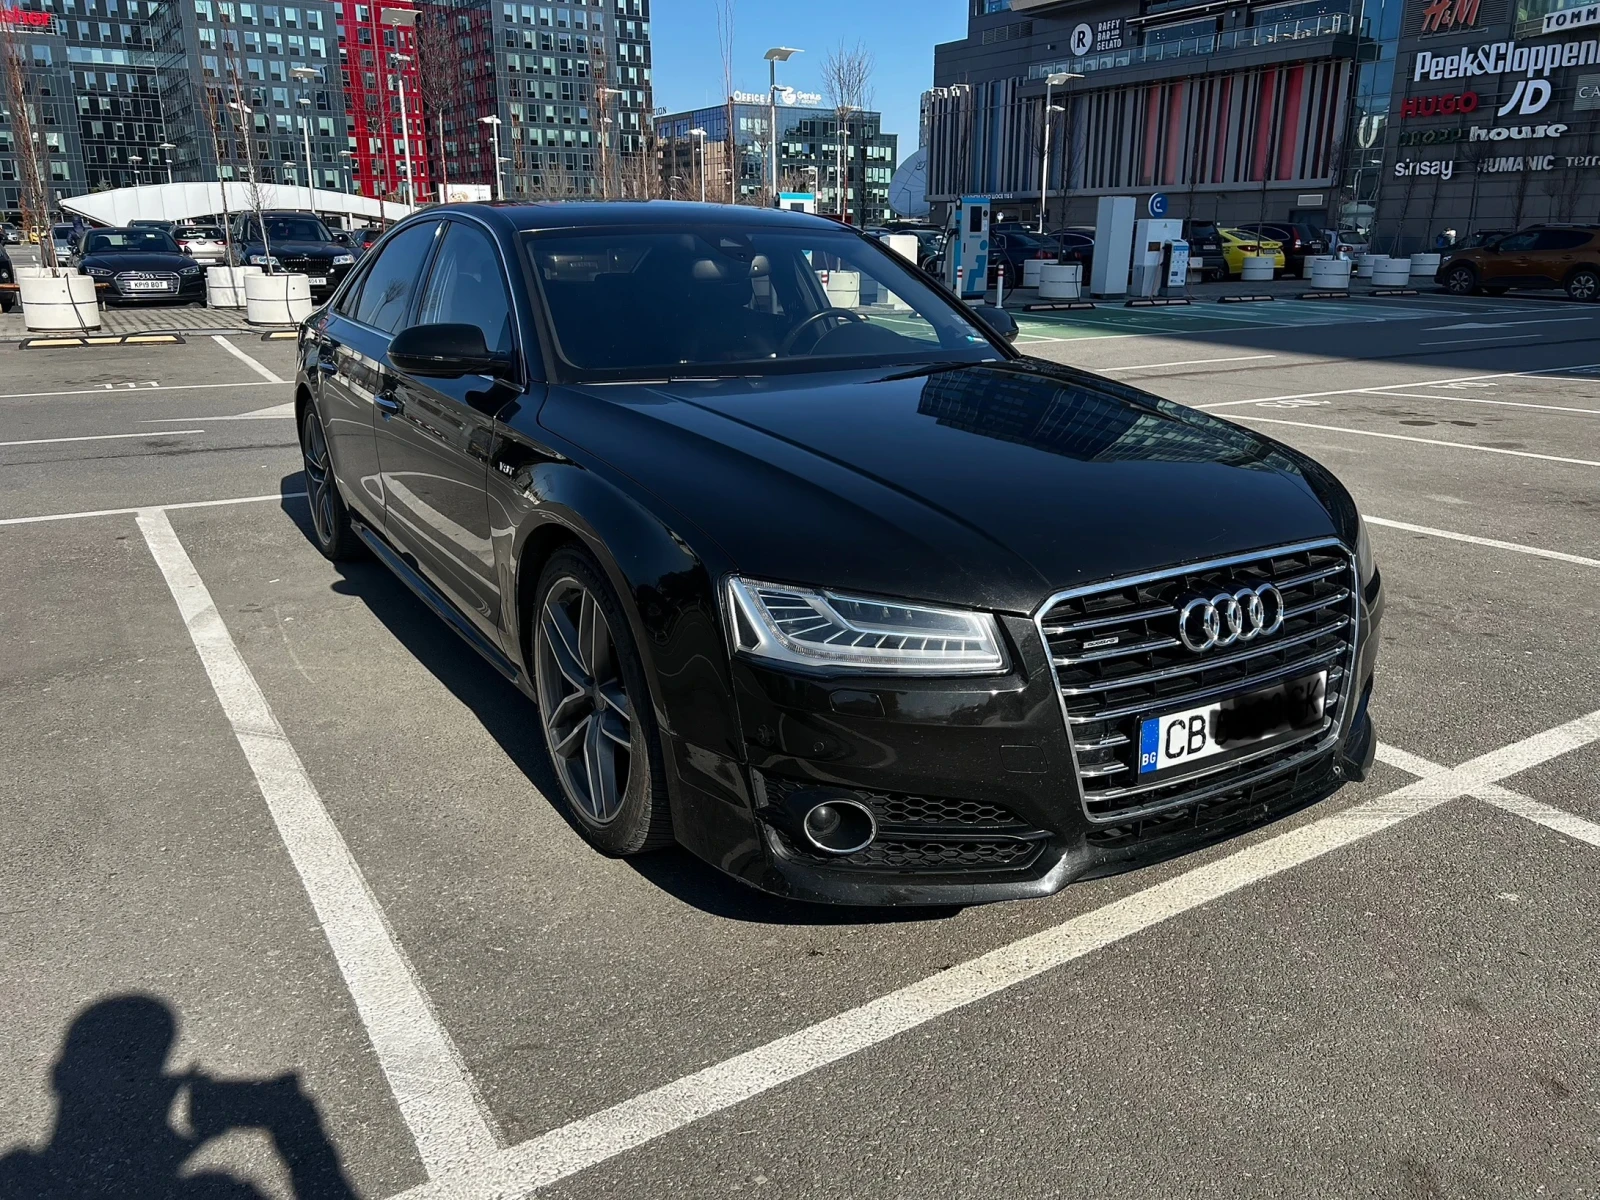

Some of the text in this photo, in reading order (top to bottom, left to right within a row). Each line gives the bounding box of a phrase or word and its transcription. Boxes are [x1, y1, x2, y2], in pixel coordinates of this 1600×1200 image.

[1098, 19, 1120, 31] RAFFY
[1421, 0, 1481, 32] H&M
[1545, 7, 1598, 28] TOMM
[1097, 39, 1122, 51] GELATO
[1098, 31, 1110, 41] BAR
[1414, 40, 1600, 82] Peek&Cloppen
[734, 90, 765, 103] OFFICE
[797, 90, 822, 101] Genius
[1401, 91, 1479, 118] HUGO
[1497, 79, 1552, 117] JD
[1469, 121, 1568, 142] house
[1477, 155, 1554, 172] HUMANIC
[1165, 715, 1207, 760] CB
[1142, 752, 1156, 766] BG
